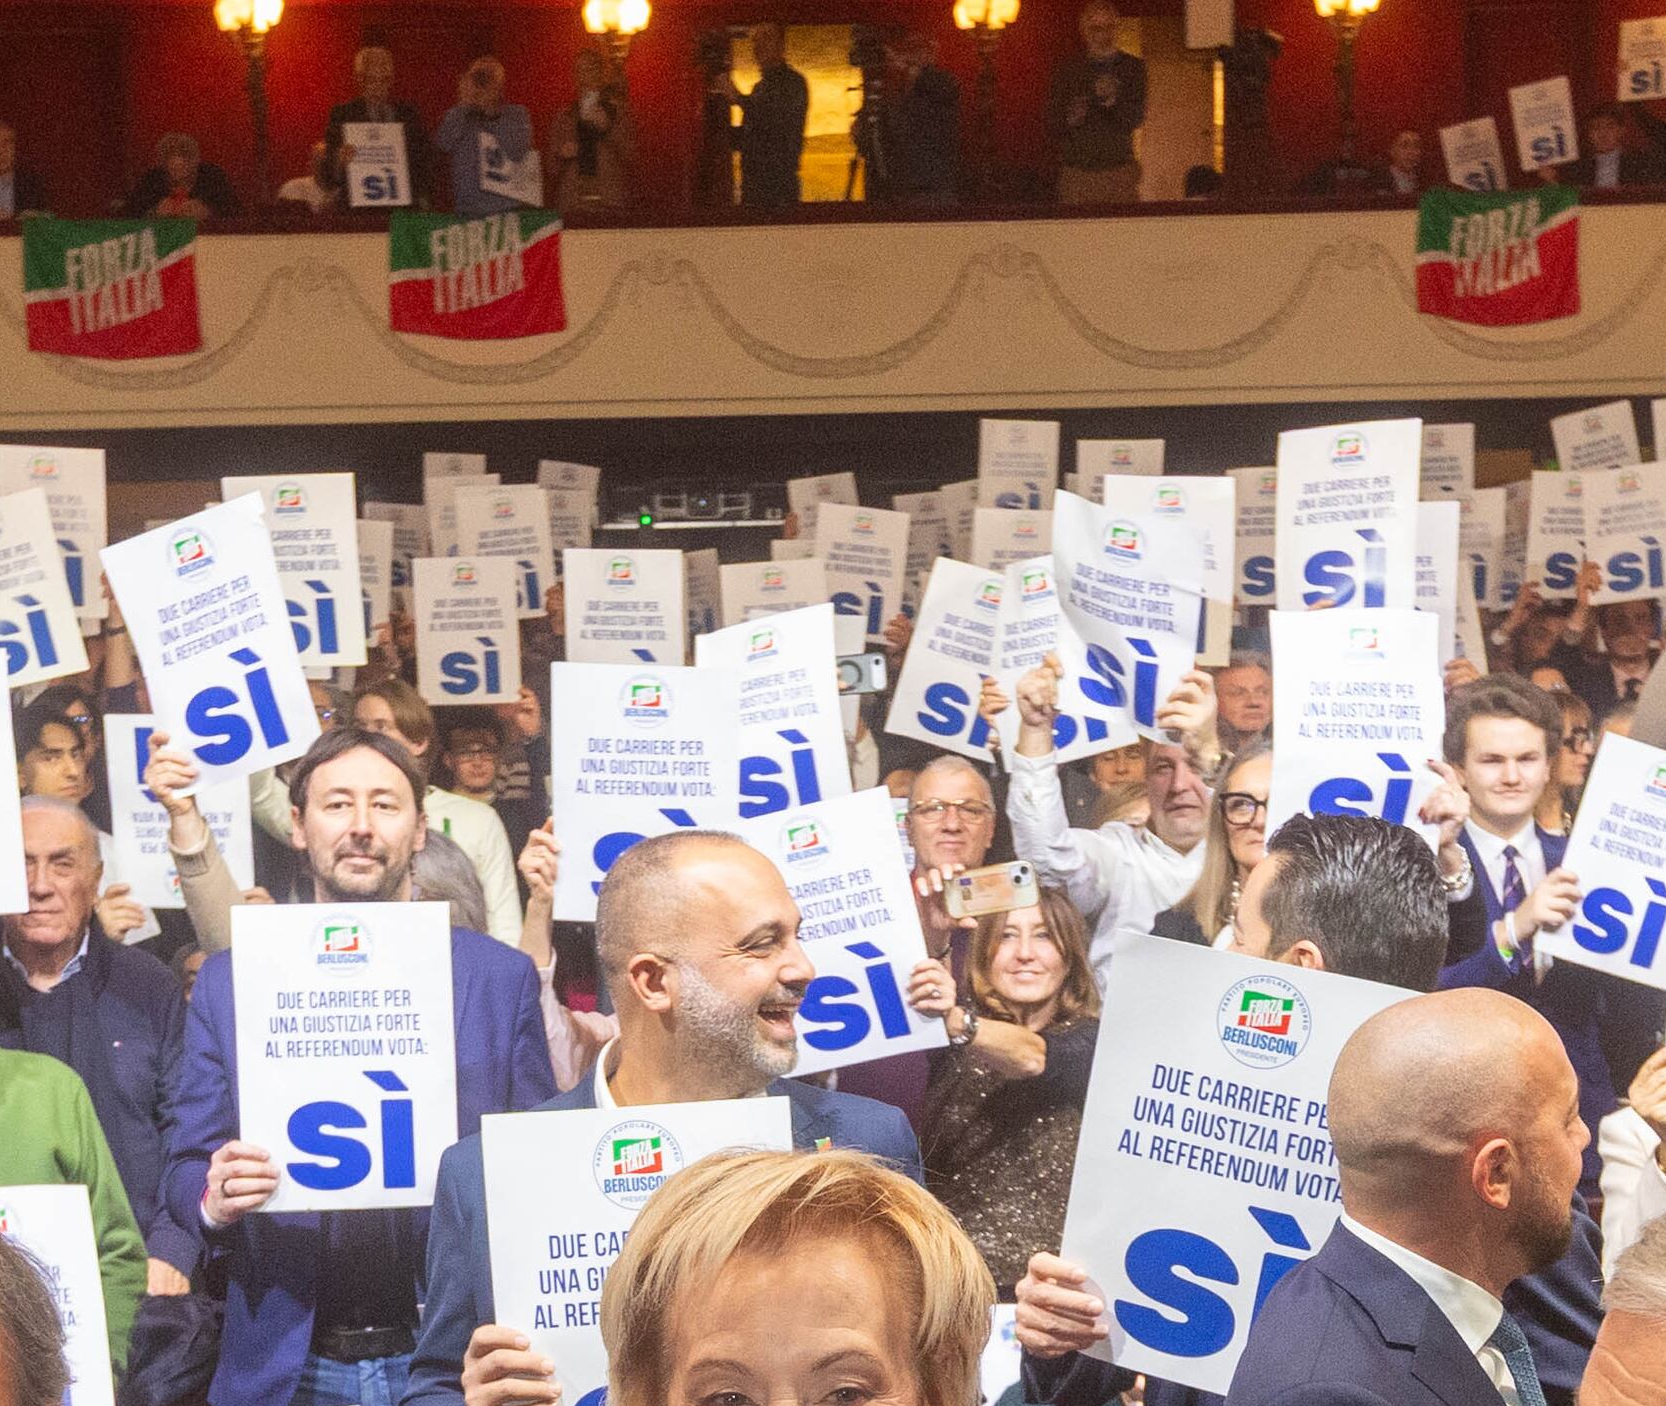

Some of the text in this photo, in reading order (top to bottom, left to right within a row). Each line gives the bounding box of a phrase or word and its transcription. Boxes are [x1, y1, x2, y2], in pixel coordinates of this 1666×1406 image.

[65, 228, 156, 290] FORZA
[430, 213, 522, 272] FORZA
[1451, 200, 1538, 260] FORZA
[433, 252, 526, 313] ITALIA
[1454, 240, 1540, 298] ITALIA
[68, 270, 162, 335] ITALIA
[1223, 1026, 1297, 1056] BERLUSCONI
[1152, 1064, 1300, 1123] DUE CARRIERE
[1134, 1096, 1174, 1128] UNA
[1179, 1107, 1280, 1156] GIUSTIZIA
[1118, 1129, 1142, 1157] AL
[1148, 1136, 1289, 1192] REFERENDUM
